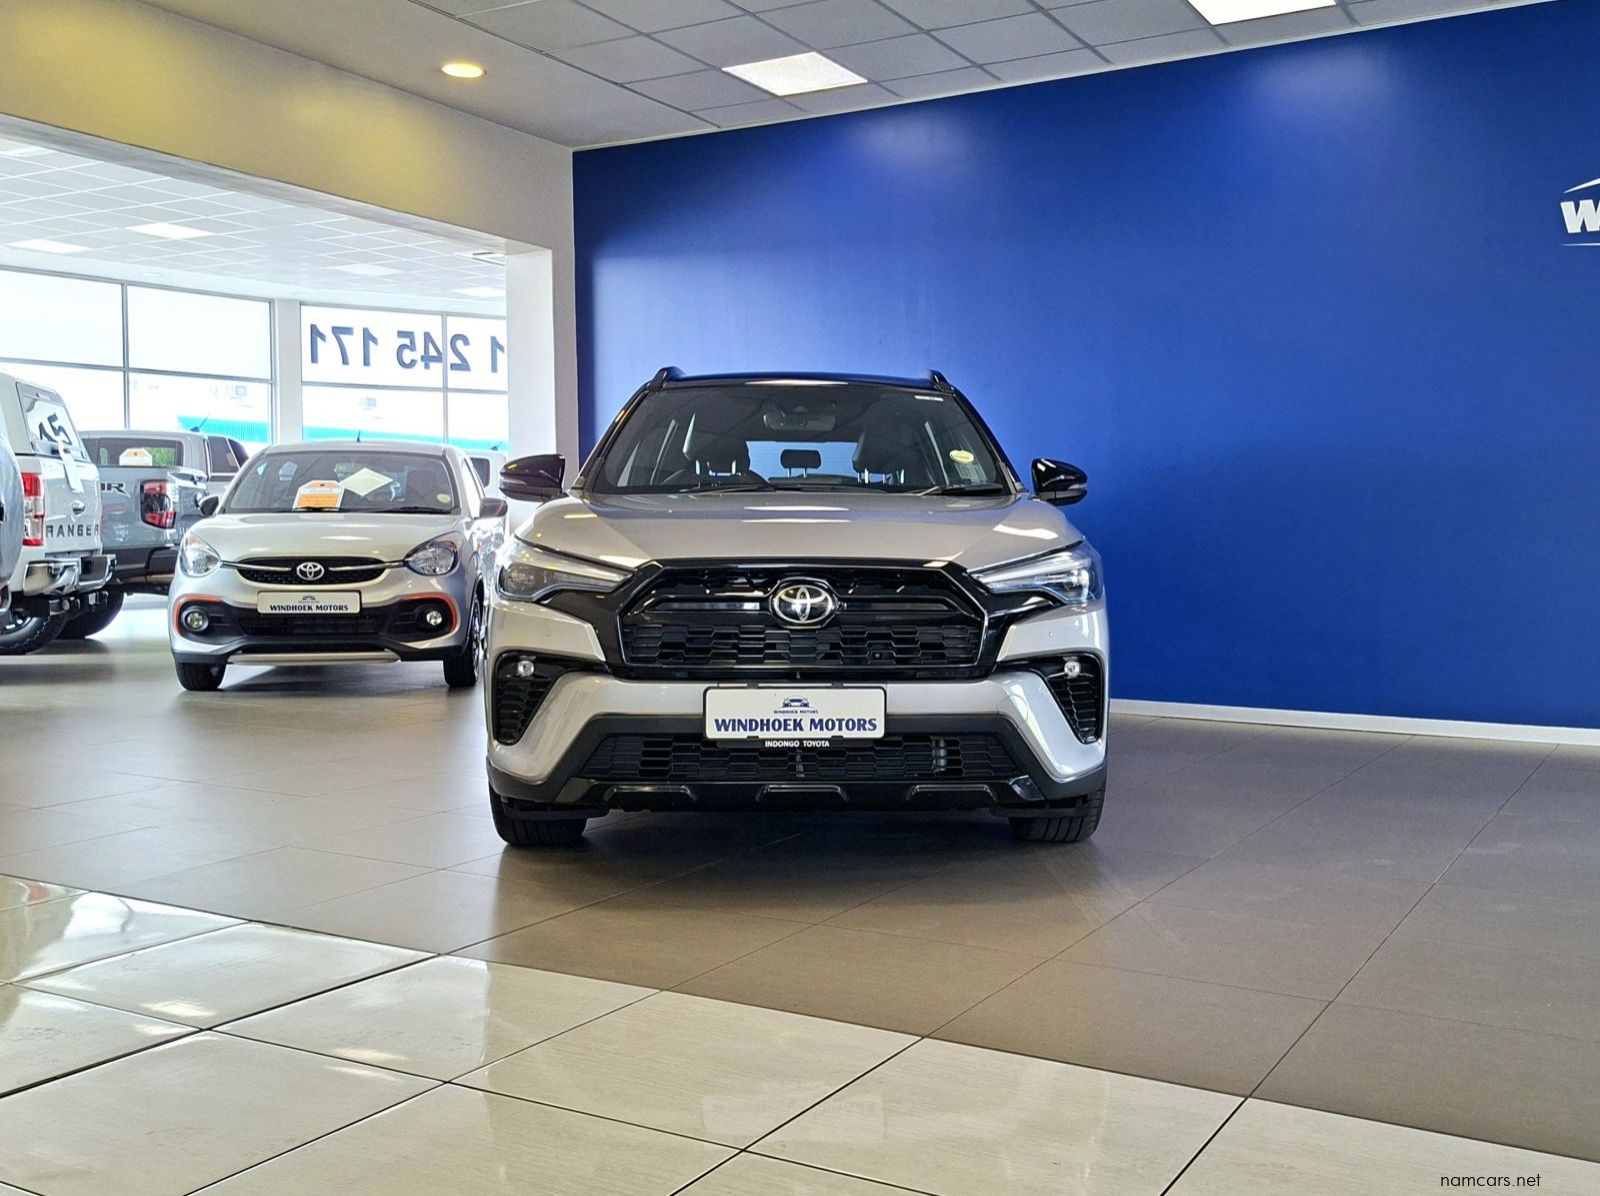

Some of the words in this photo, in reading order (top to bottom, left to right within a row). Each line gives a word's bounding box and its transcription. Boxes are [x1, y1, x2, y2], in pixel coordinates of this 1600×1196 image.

[269, 604, 313, 612] WINDHOEK
[315, 604, 349, 612] MOTORS
[714, 718, 804, 732] WINDHOEK
[809, 718, 878, 732] MOTORS
[764, 740, 800, 748] INDONGO
[803, 740, 830, 748] TOYOTA
